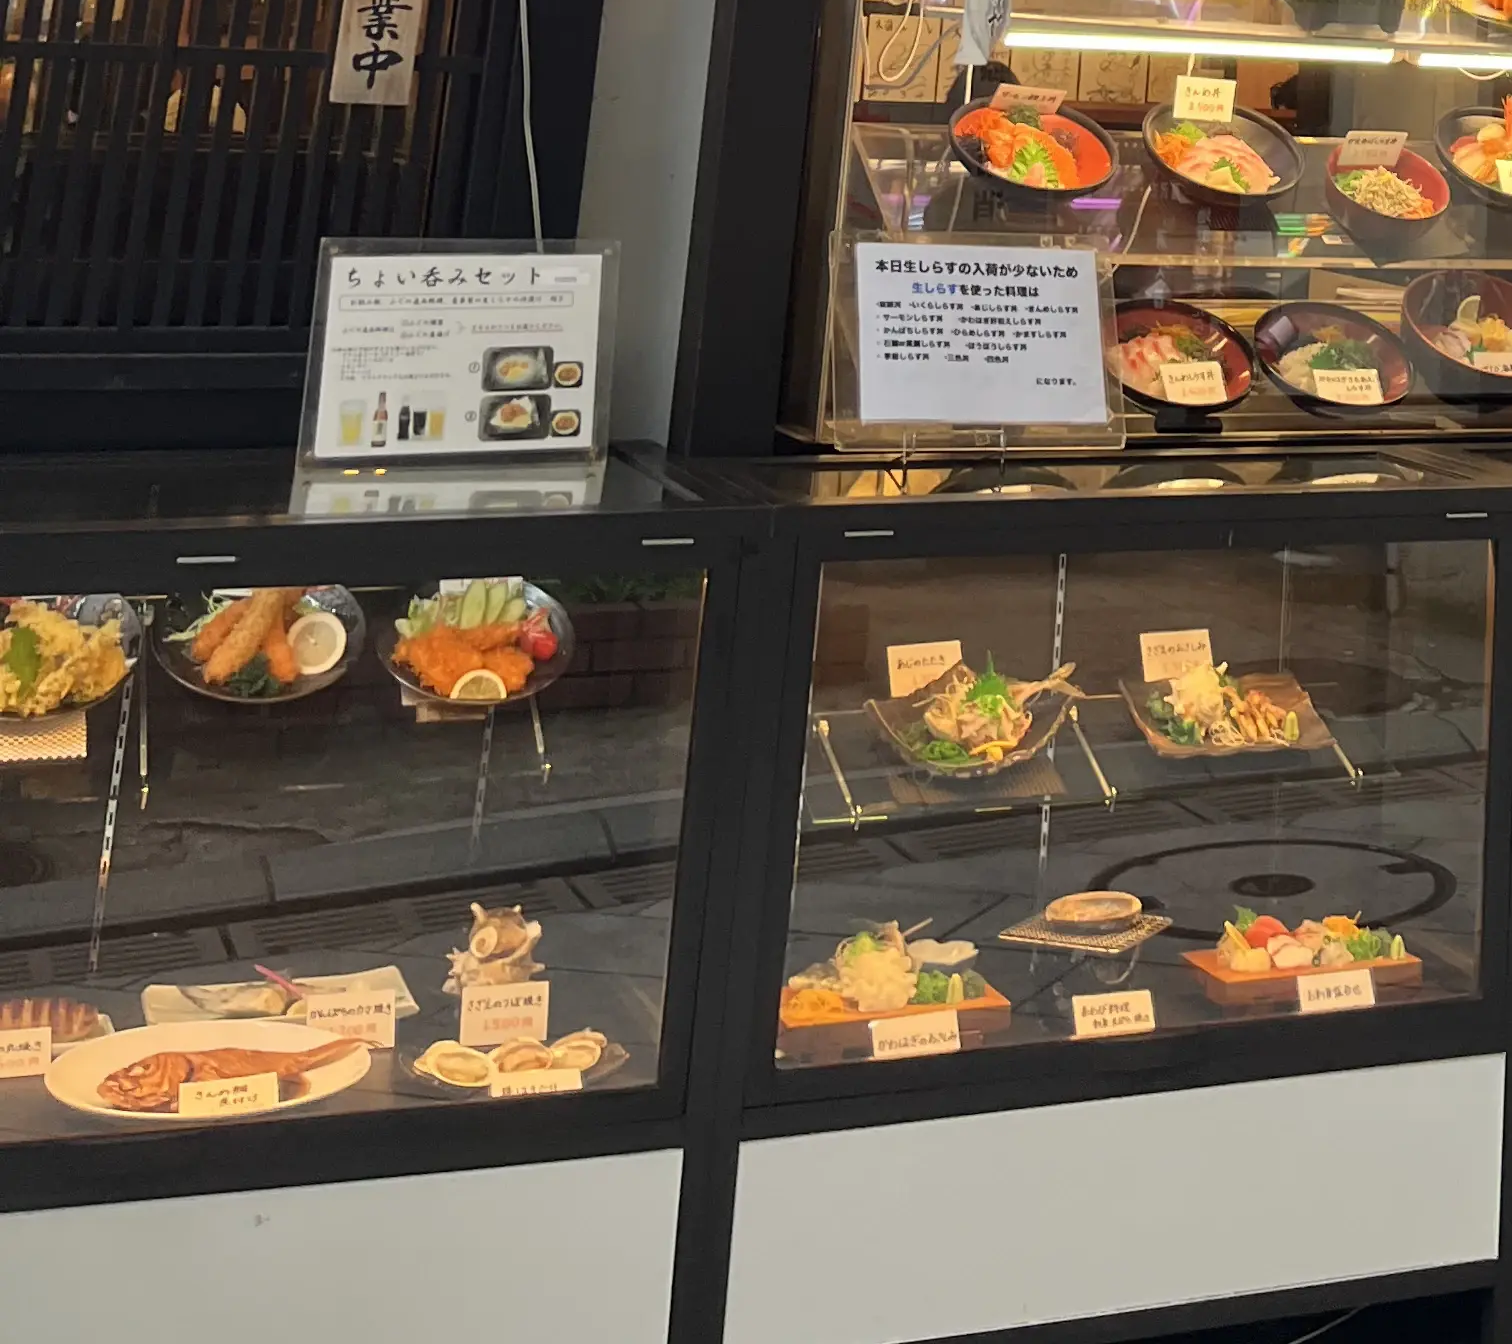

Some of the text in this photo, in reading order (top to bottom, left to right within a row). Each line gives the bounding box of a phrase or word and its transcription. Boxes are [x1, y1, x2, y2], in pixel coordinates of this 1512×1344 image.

[347, 266, 542, 290] ちょい呑みセット
[875, 259, 1079, 279] 本日生しらすの入荷が少ないため
[911, 281, 1040, 298] 生しらすを使った料理は
